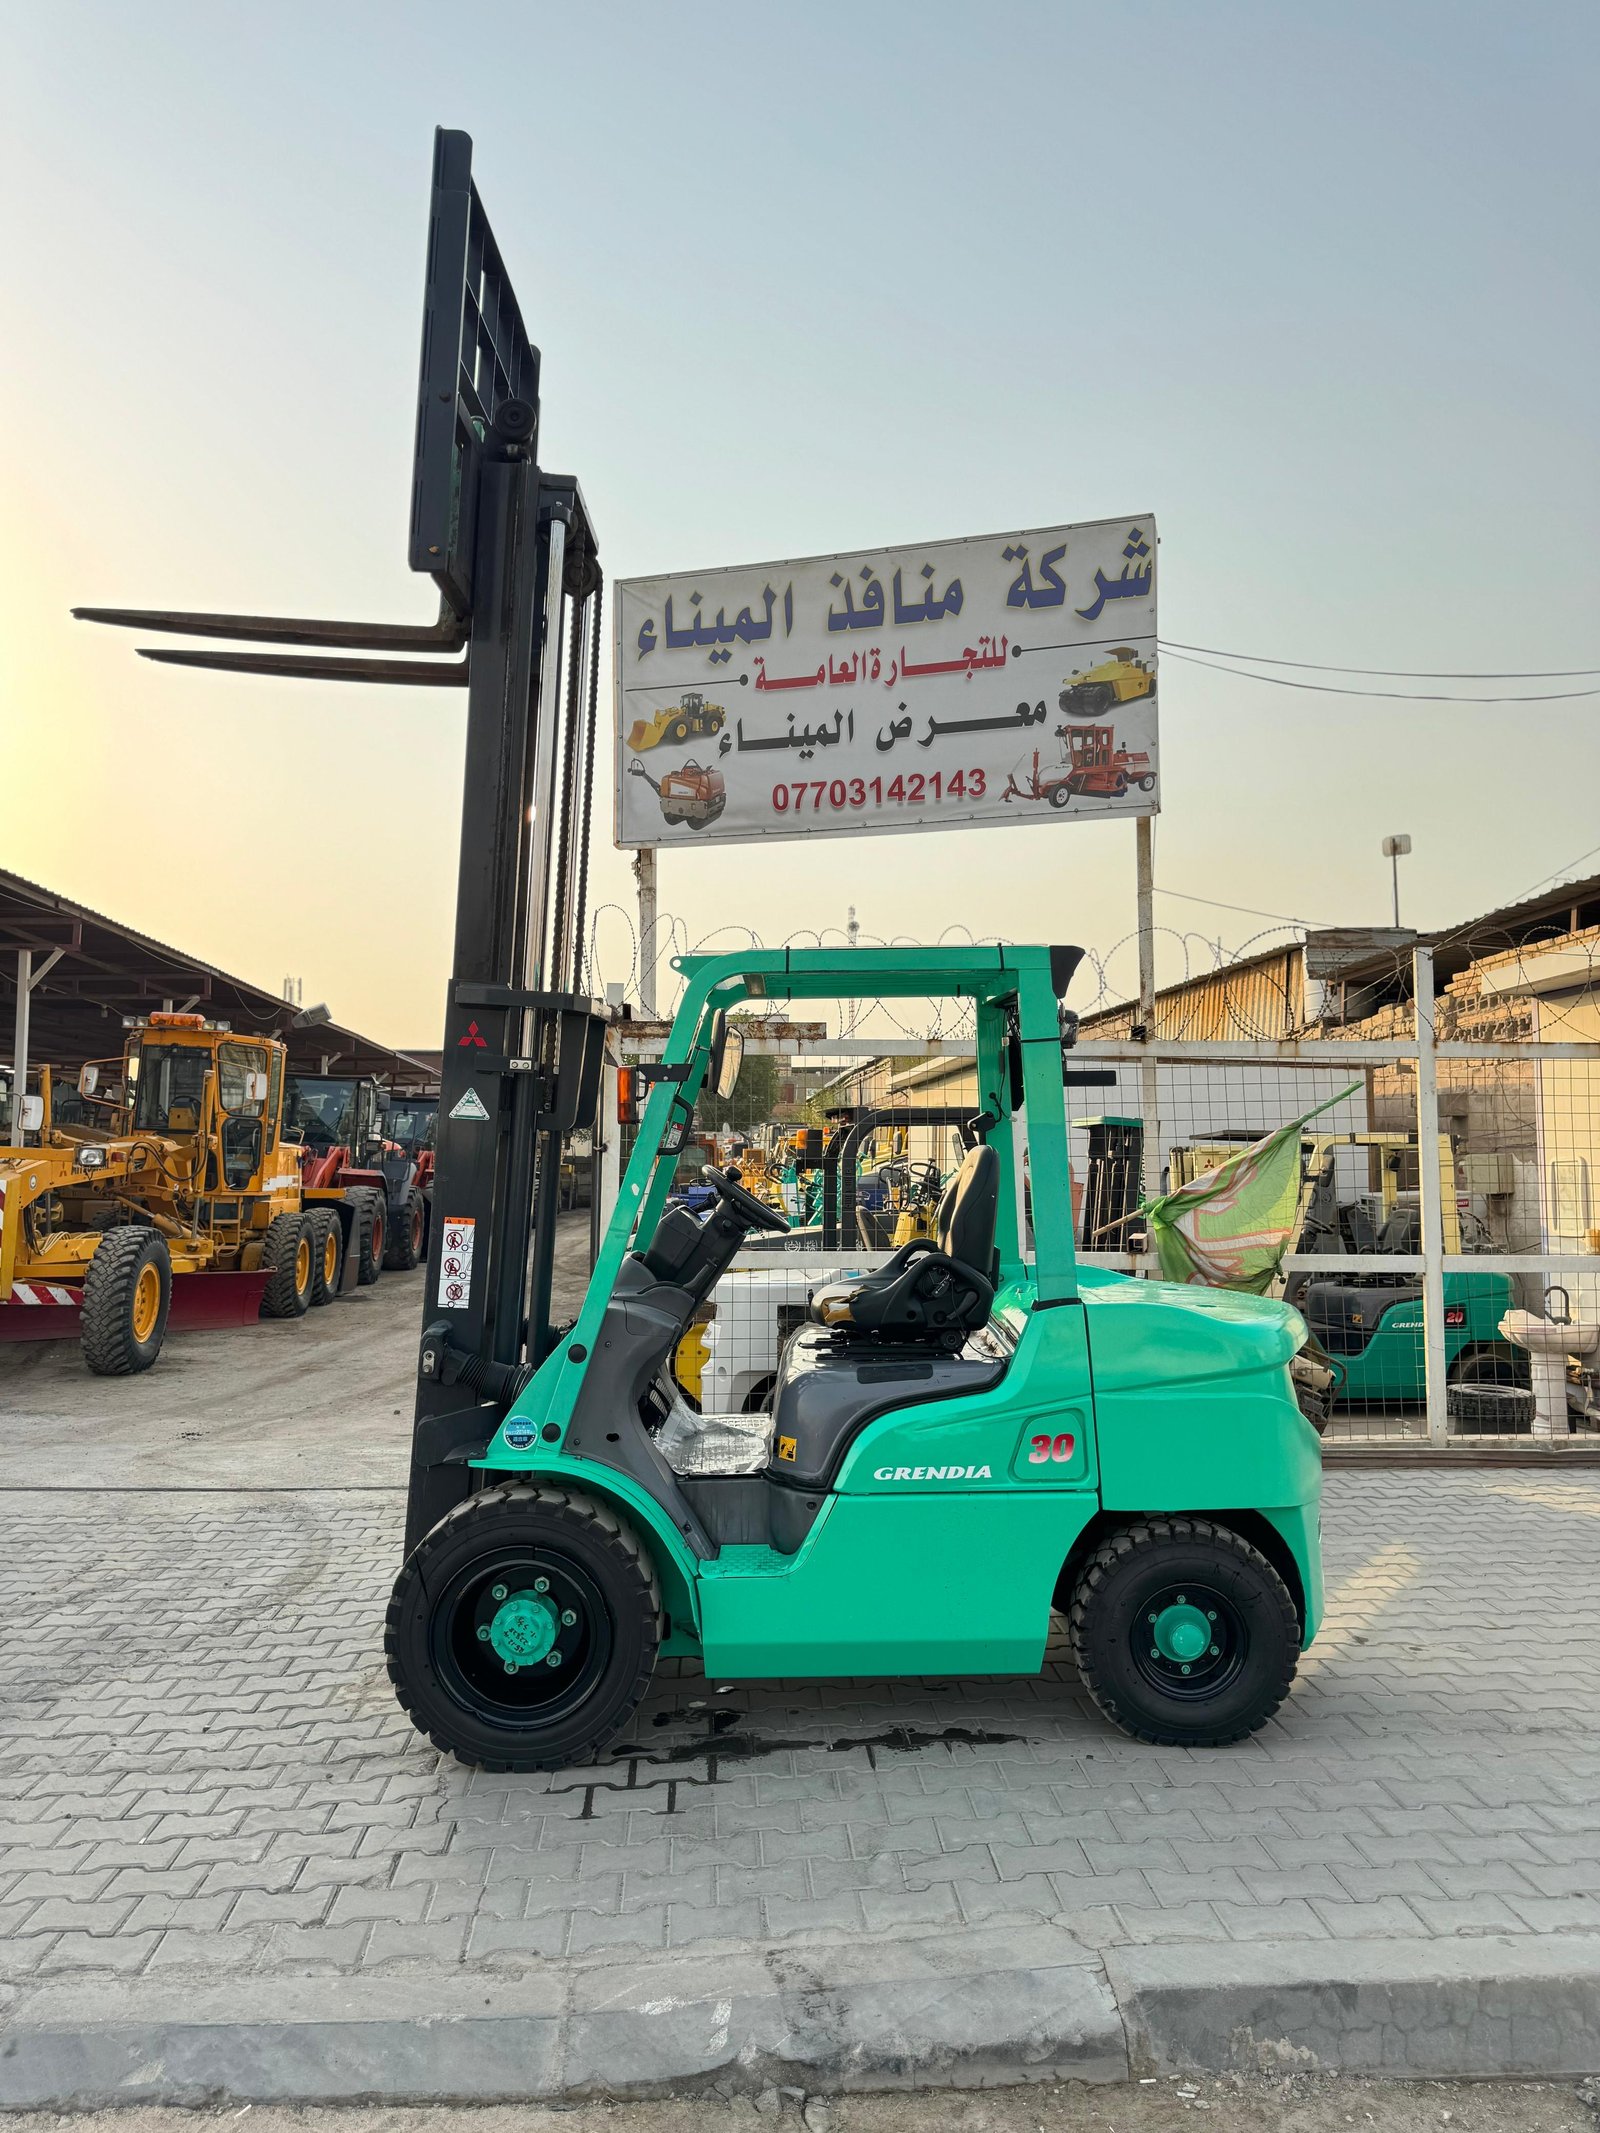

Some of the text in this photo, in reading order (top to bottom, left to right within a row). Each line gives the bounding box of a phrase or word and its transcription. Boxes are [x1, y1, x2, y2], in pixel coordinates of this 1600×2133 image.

[637, 527, 1153, 664] شركة منافذ الميناء
[754, 634, 1009, 691] للتجارة العامة
[718, 700, 1047, 759] معرض الميناء
[772, 768, 987, 812] 07703142143
[1391, 1321, 1424, 1329] GREND
[1446, 1311, 1464, 1323] 20
[1028, 1433, 1075, 1464] 30
[873, 1465, 992, 1481] GRENDIA
